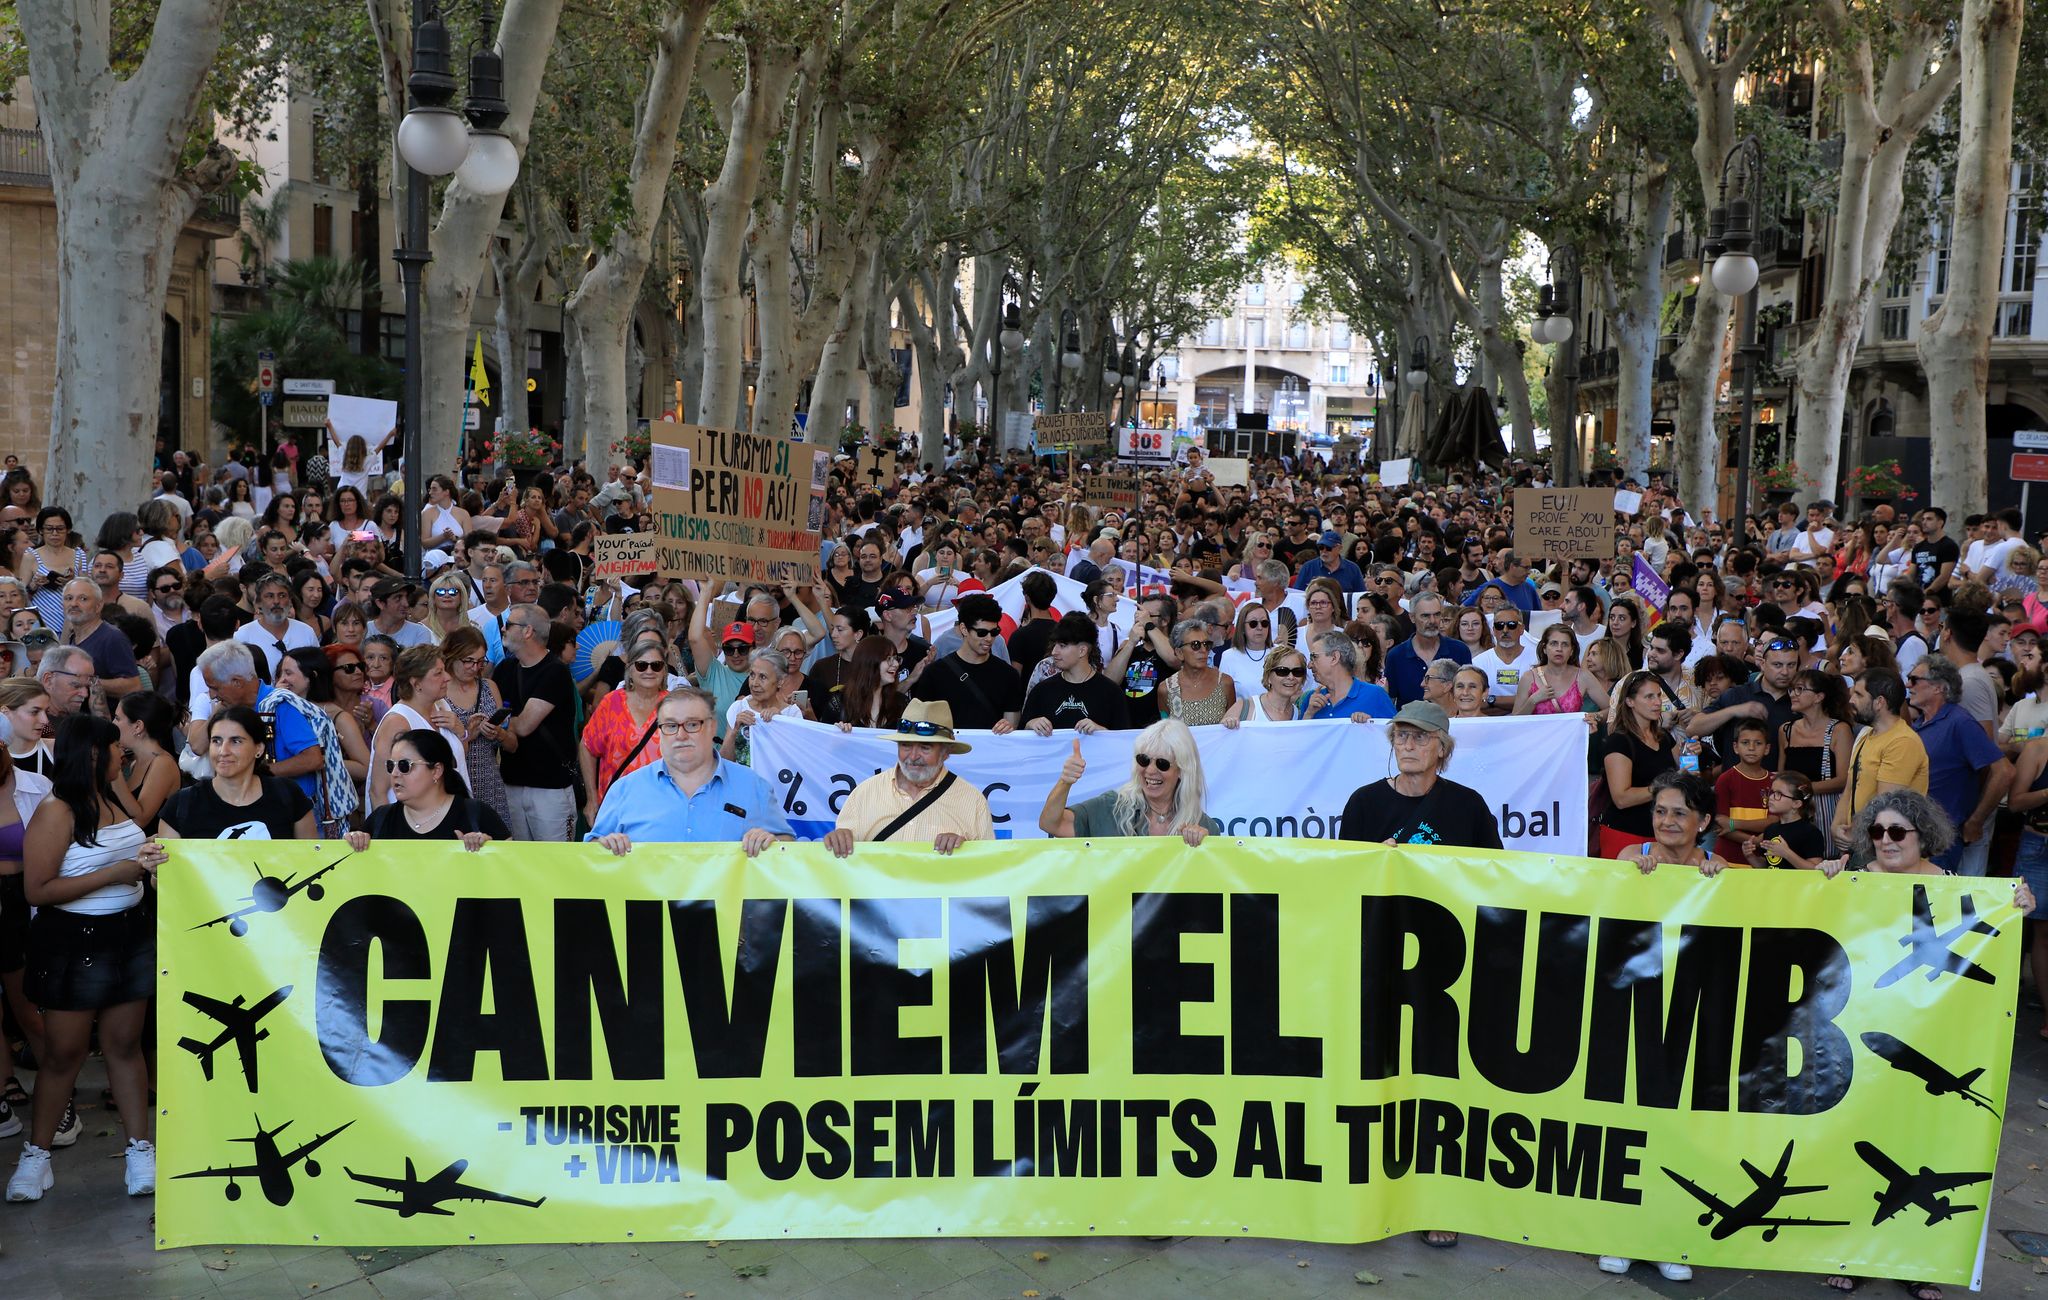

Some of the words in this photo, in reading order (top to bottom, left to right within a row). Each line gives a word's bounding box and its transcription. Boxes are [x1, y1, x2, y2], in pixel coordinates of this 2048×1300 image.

[290, 405, 326, 413] RIALTO
[1050, 429, 1061, 443] NO
[1130, 432, 1162, 449] SOS
[1090, 478, 1102, 488] EL
[691, 468, 739, 516] PERO
[743, 476, 763, 519] NO
[1542, 494, 1579, 511] EU!!
[1530, 512, 1569, 523] PROVE
[1580, 512, 1604, 525] YOU
[1529, 526, 1562, 536] CARE
[1566, 526, 1612, 538] ABOUT
[1543, 539, 1595, 552] PEOPLE
[315, 894, 1089, 1087] CANVIEM
[1131, 892, 1323, 1078] EL
[1360, 894, 1854, 1116] RUMB
[520, 1104, 680, 1145] TURISME
[706, 1099, 956, 1181] POSEM
[973, 1082, 1218, 1179] LÍMITS
[1233, 1100, 1323, 1183] AL
[1336, 1098, 1648, 1206] TURISME
[595, 1144, 681, 1185] VIDA
